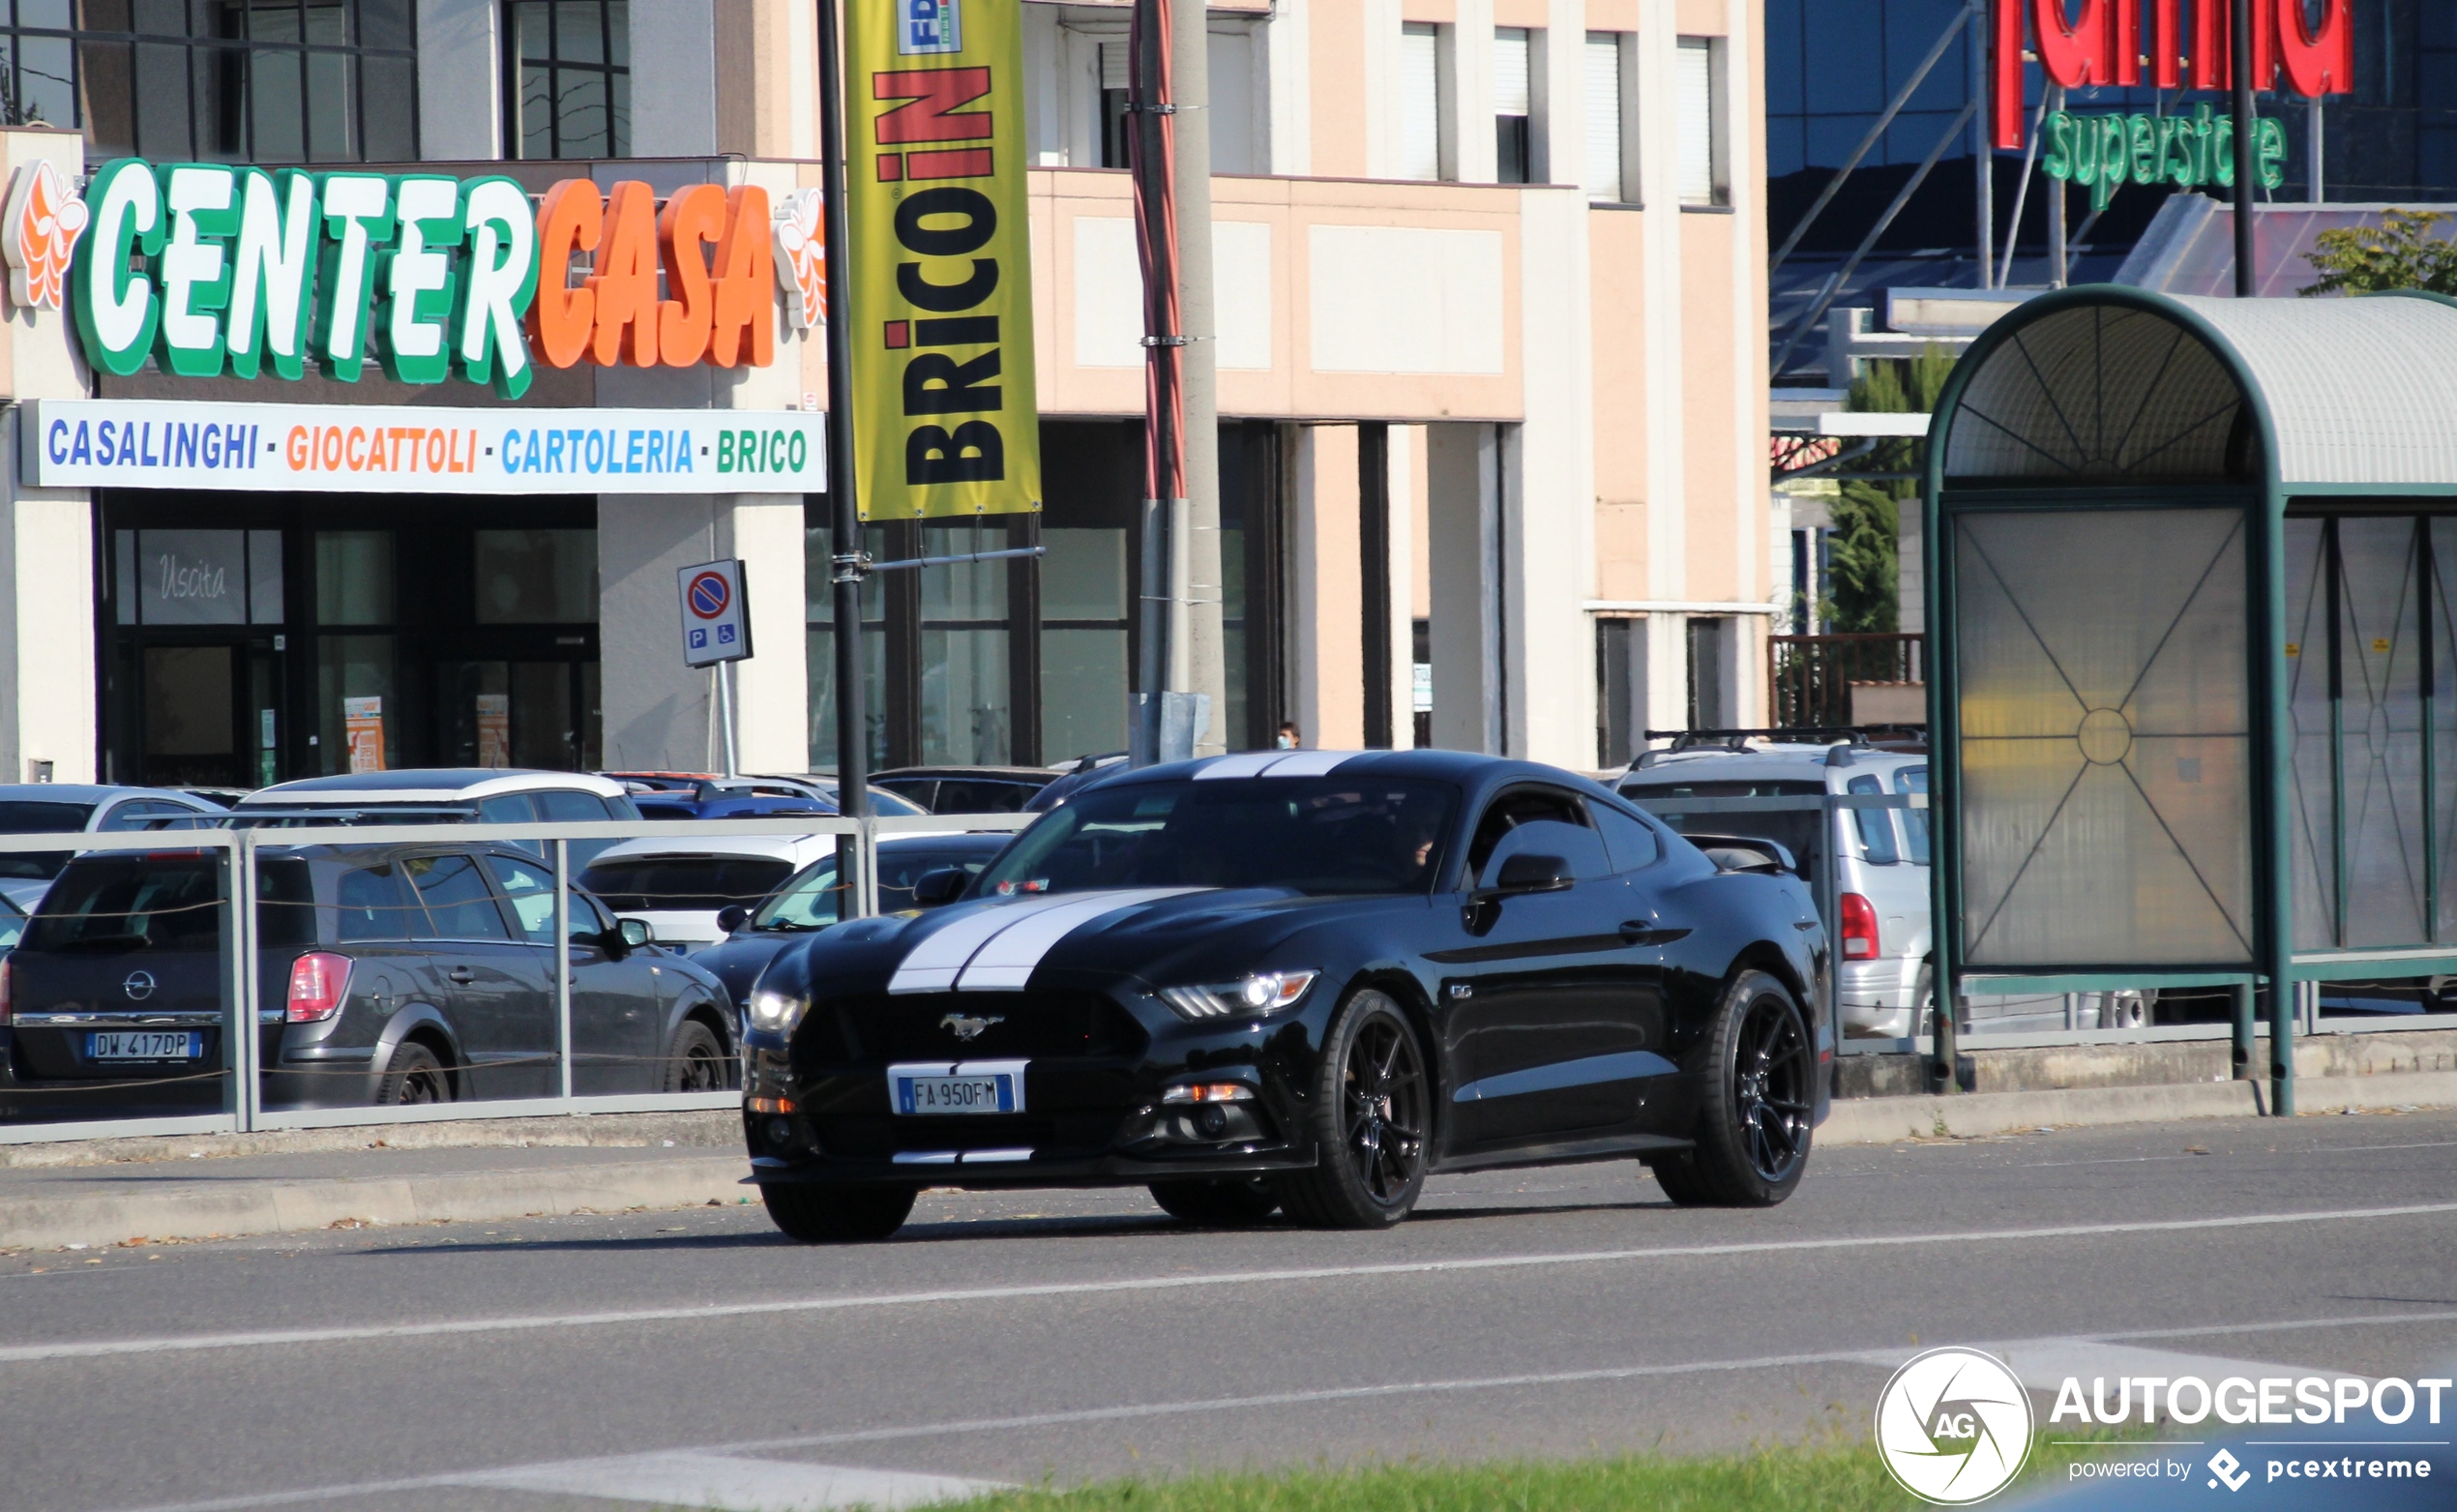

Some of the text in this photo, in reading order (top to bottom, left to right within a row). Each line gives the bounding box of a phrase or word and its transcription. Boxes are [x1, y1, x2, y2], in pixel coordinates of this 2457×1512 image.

[74, 157, 775, 399] CENTER CASA
[48, 419, 807, 474] CASALINGHI GIOCATTOLI CARTOLERIA BRICO
[160, 554, 225, 599] Uscita
